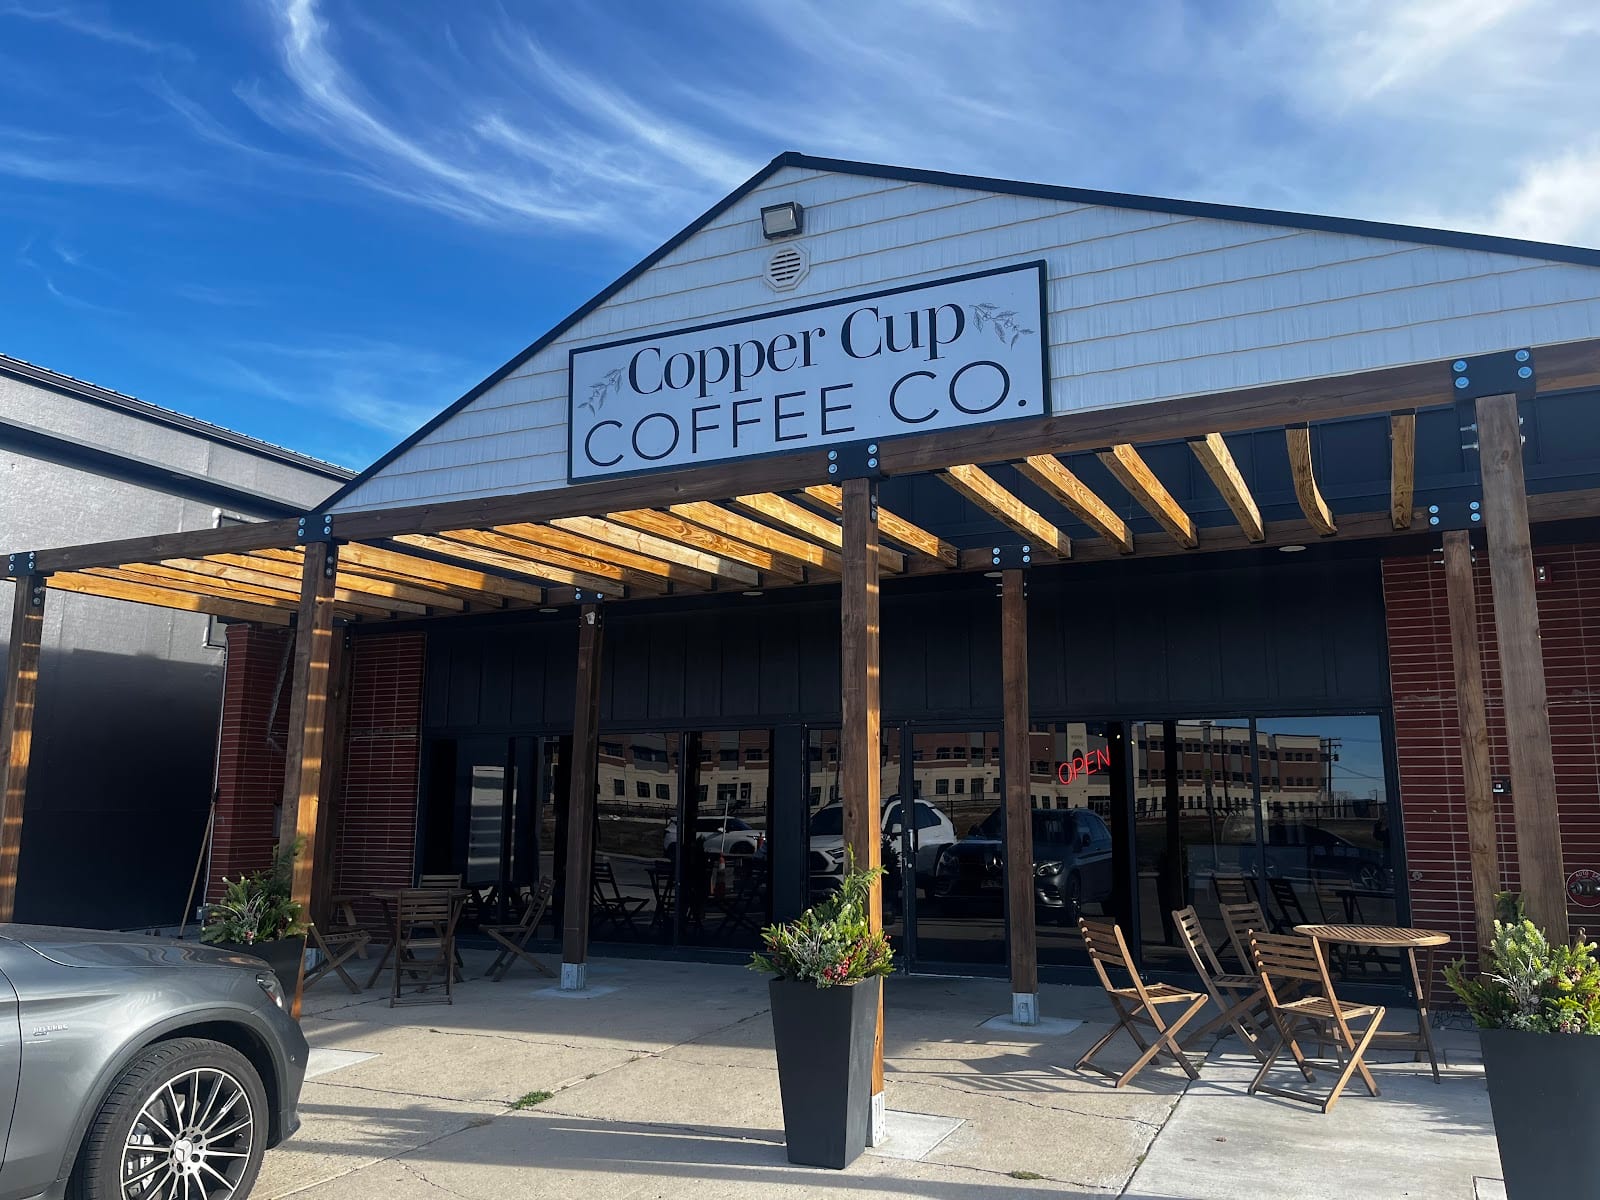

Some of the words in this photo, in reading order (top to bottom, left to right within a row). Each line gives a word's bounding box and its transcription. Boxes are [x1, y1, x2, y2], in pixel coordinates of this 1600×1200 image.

[628, 328, 826, 399] Copper
[840, 302, 966, 362] Cup
[584, 382, 855, 467] COFFEE
[889, 360, 1027, 424] CO.
[1058, 745, 1111, 785] OPEN
